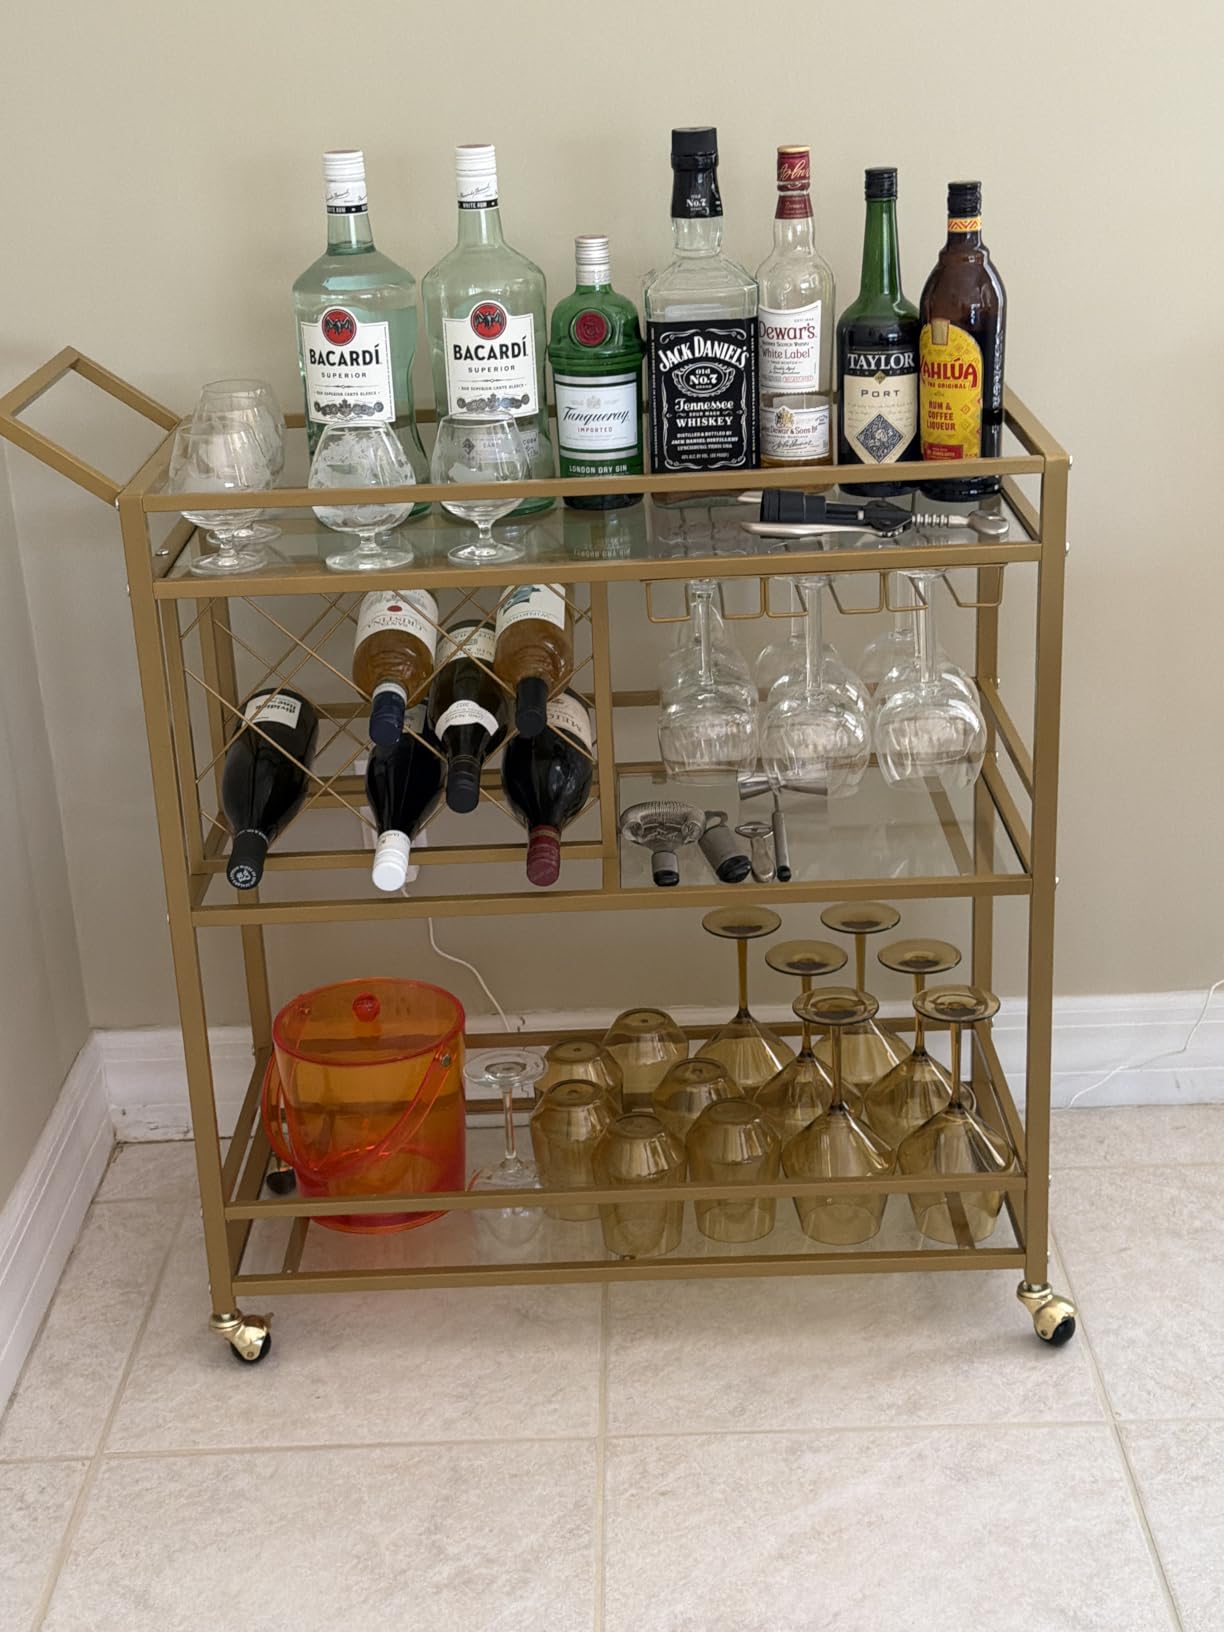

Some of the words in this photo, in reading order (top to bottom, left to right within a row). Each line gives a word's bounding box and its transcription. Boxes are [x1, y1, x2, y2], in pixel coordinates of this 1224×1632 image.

[759, 320, 816, 340] Dewar's
[453, 335, 527, 361] BACARDÍ
[657, 342, 693, 372] JACK
[693, 335, 749, 369] DANIEL'S
[309, 343, 380, 367] BACARDÍ
[848, 352, 915, 370] TAYLOR
[321, 371, 367, 379] SUPERIOR
[468, 365, 516, 374] SUPERIOR
[689, 374, 718, 385] No.7
[861, 389, 900, 398] PORT
[674, 398, 734, 412] Tennessee
[929, 400, 943, 410] RUM
[563, 406, 630, 426] Tanqueray
[928, 410, 954, 421] COFFEE
[676, 416, 733, 428] WHISKEY
[927, 420, 956, 431] LIQUEUR
[569, 465, 596, 474] LONDON
[598, 466, 612, 474] DRY
[615, 464, 628, 473] GIN
